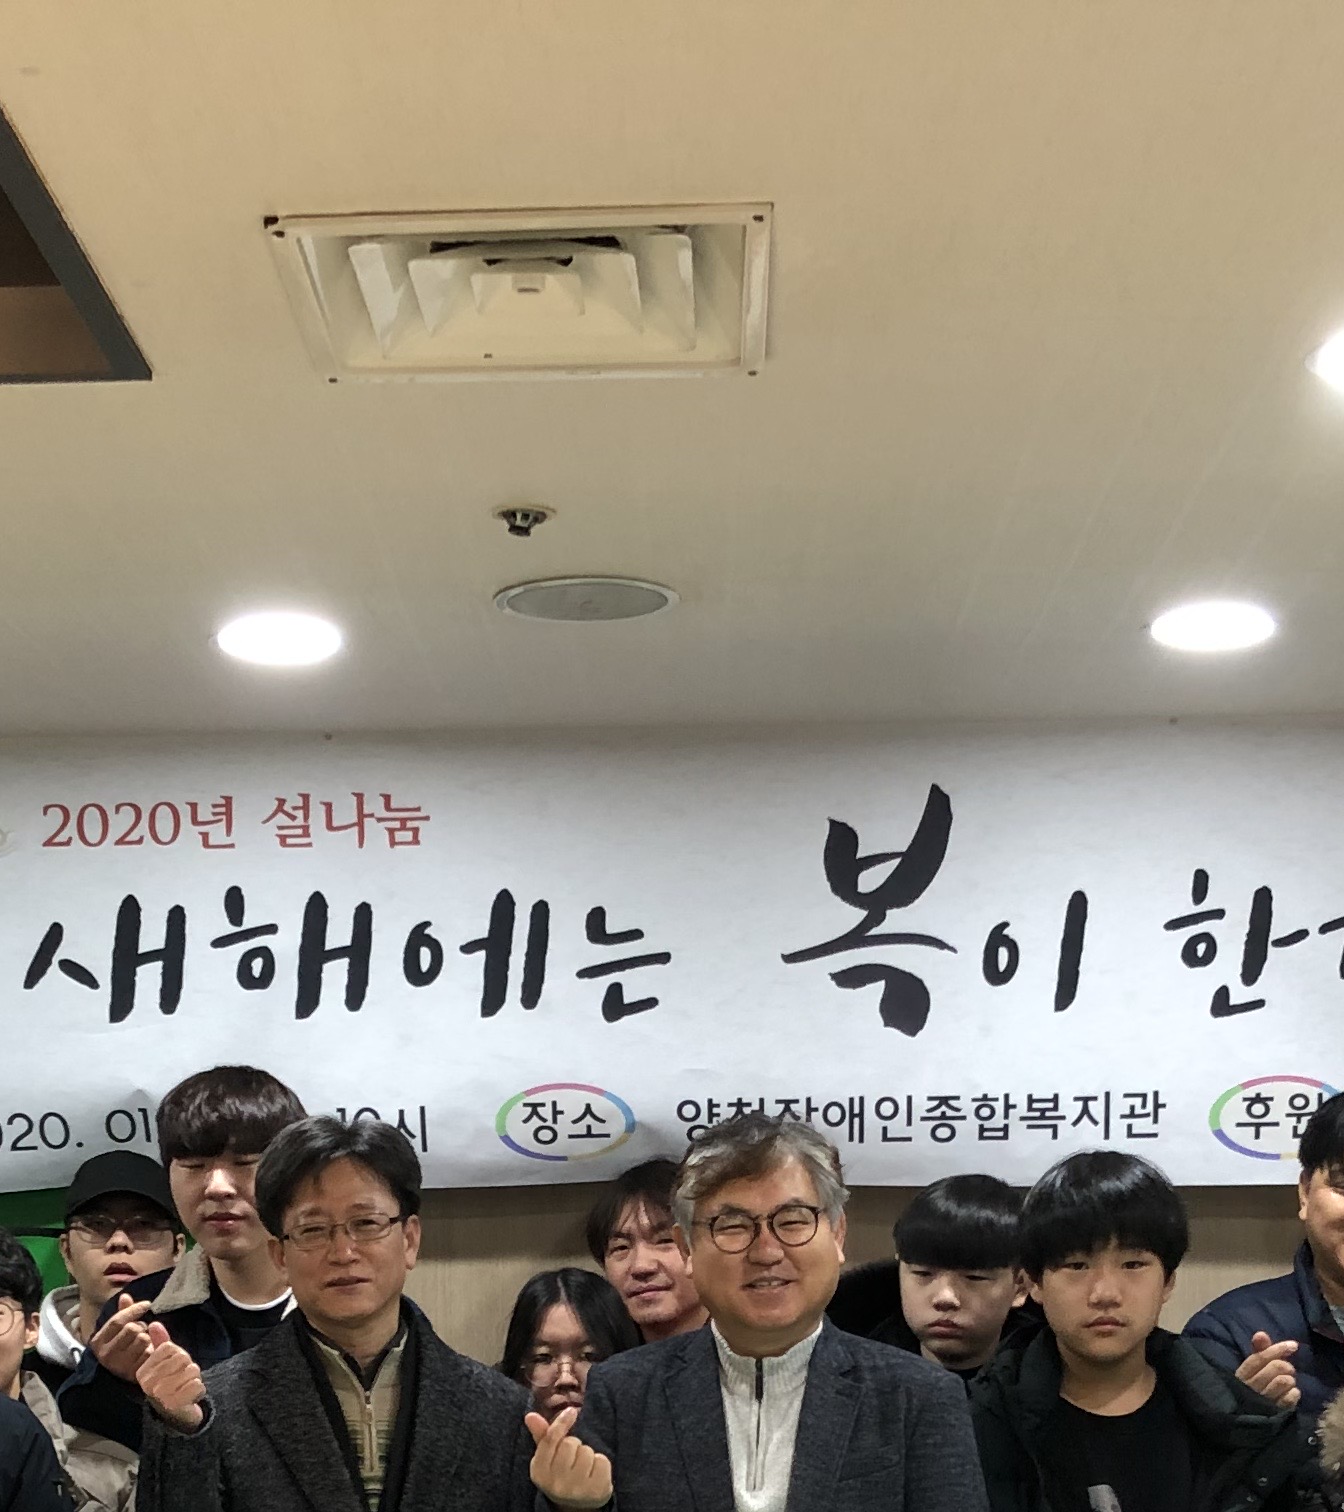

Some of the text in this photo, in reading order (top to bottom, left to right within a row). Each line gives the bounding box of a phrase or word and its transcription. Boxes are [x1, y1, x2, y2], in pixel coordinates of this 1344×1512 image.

[41, 791, 431, 849] 2020년 설나눔
[23, 885, 672, 1024] 새해에는
[780, 782, 1089, 1038] 복이
[519, 1098, 613, 1147] 장소
